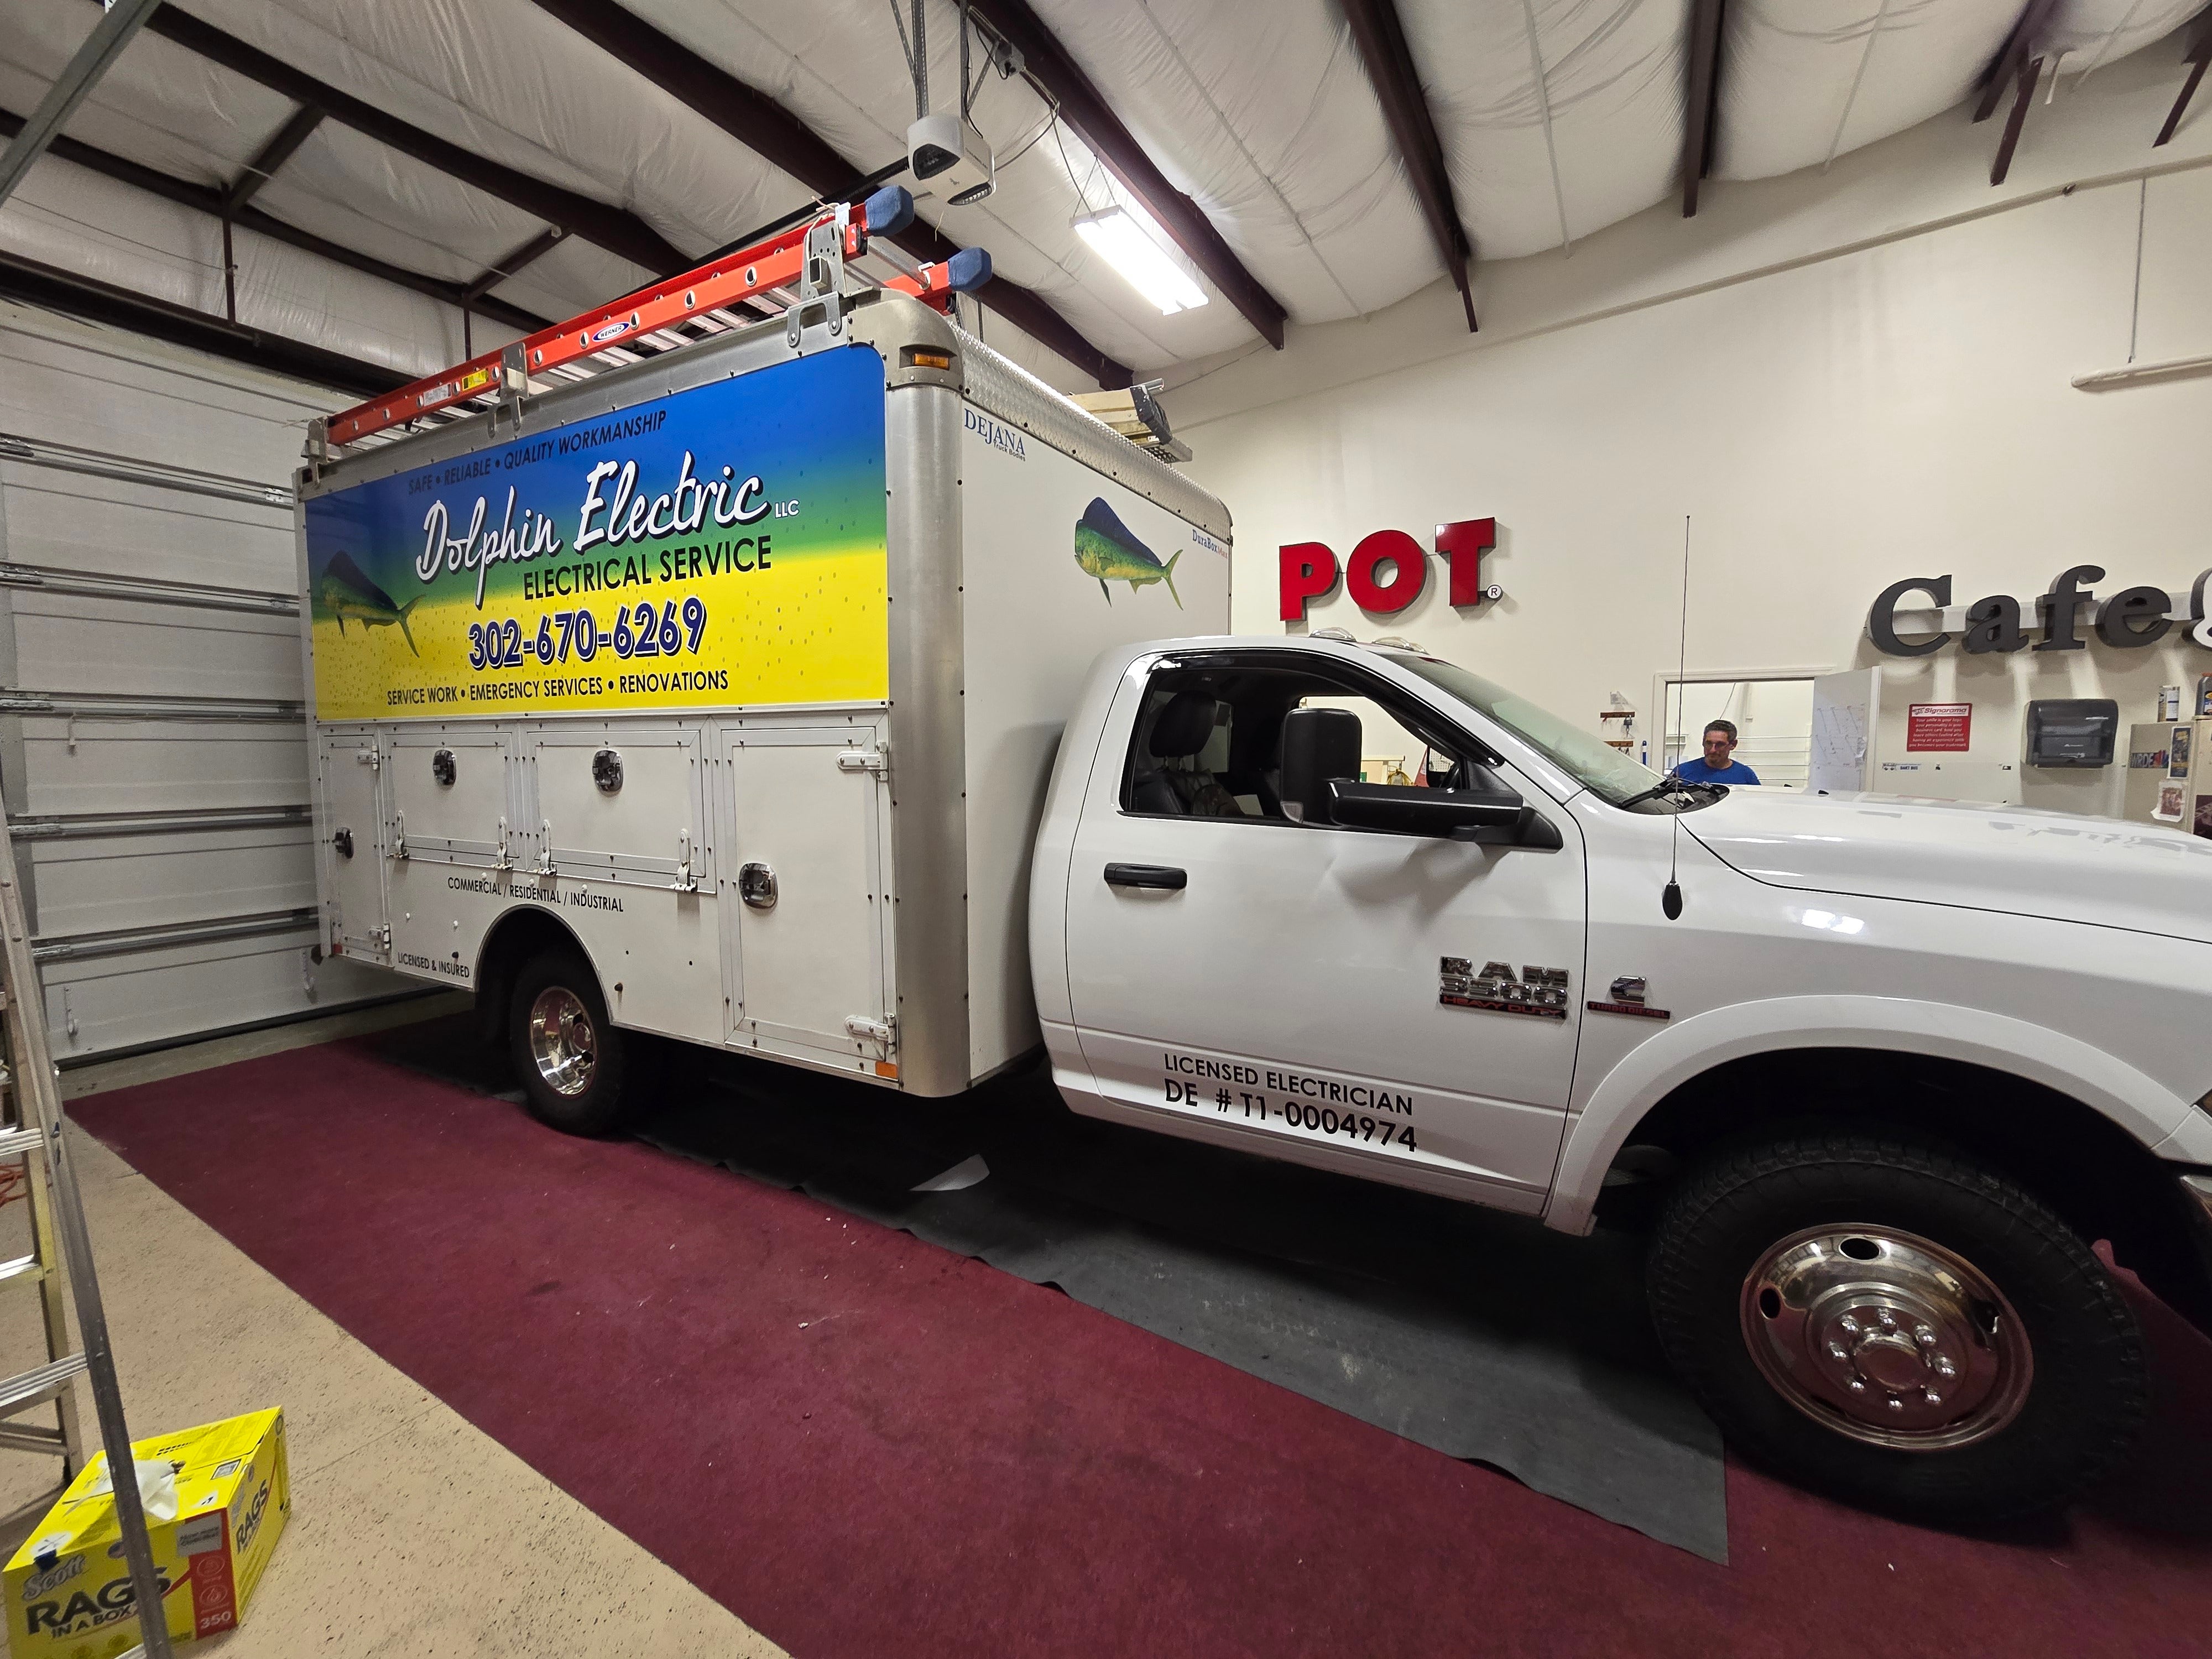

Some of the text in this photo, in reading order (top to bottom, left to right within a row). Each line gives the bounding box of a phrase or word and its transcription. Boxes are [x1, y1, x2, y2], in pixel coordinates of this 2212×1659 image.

[600, 325, 622, 338] WERNER
[964, 408, 1025, 456] DEJANA
[408, 410, 666, 495] SAFE RELIABLE QUALITY WORKMANSHIP
[993, 441, 1026, 462] Truck Bodies
[415, 448, 800, 607] Dolphin Electric LLC
[524, 535, 771, 601] ELECTRICAL SERVICE
[1279, 517, 1496, 622] POT
[1867, 565, 2173, 656] Cafe
[468, 597, 707, 671] 302-670-6269
[387, 670, 728, 706] SERVICE WORK EMERGENCY SERVICES RENOVATIONS
[447, 877, 502, 896] COMMERCIAL
[509, 884, 561, 904] RESIDENTIAL
[570, 891, 624, 912] INDUSTRIAL
[398, 952, 470, 978] LICENSED & INSURED
[1440, 956, 1569, 988] RAM
[1439, 974, 1568, 1008] 3500
[1443, 995, 1564, 1016] HEAVY DUTY
[1164, 1053, 1413, 1116] LICENSED ELECTRICIAN
[1164, 1078, 1198, 1107] DE
[236, 1479, 268, 1554] RAGS
[22, 1554, 86, 1601] Scott
[52, 1604, 133, 1639] IN A BOX
[200, 1610, 232, 1629] 350
